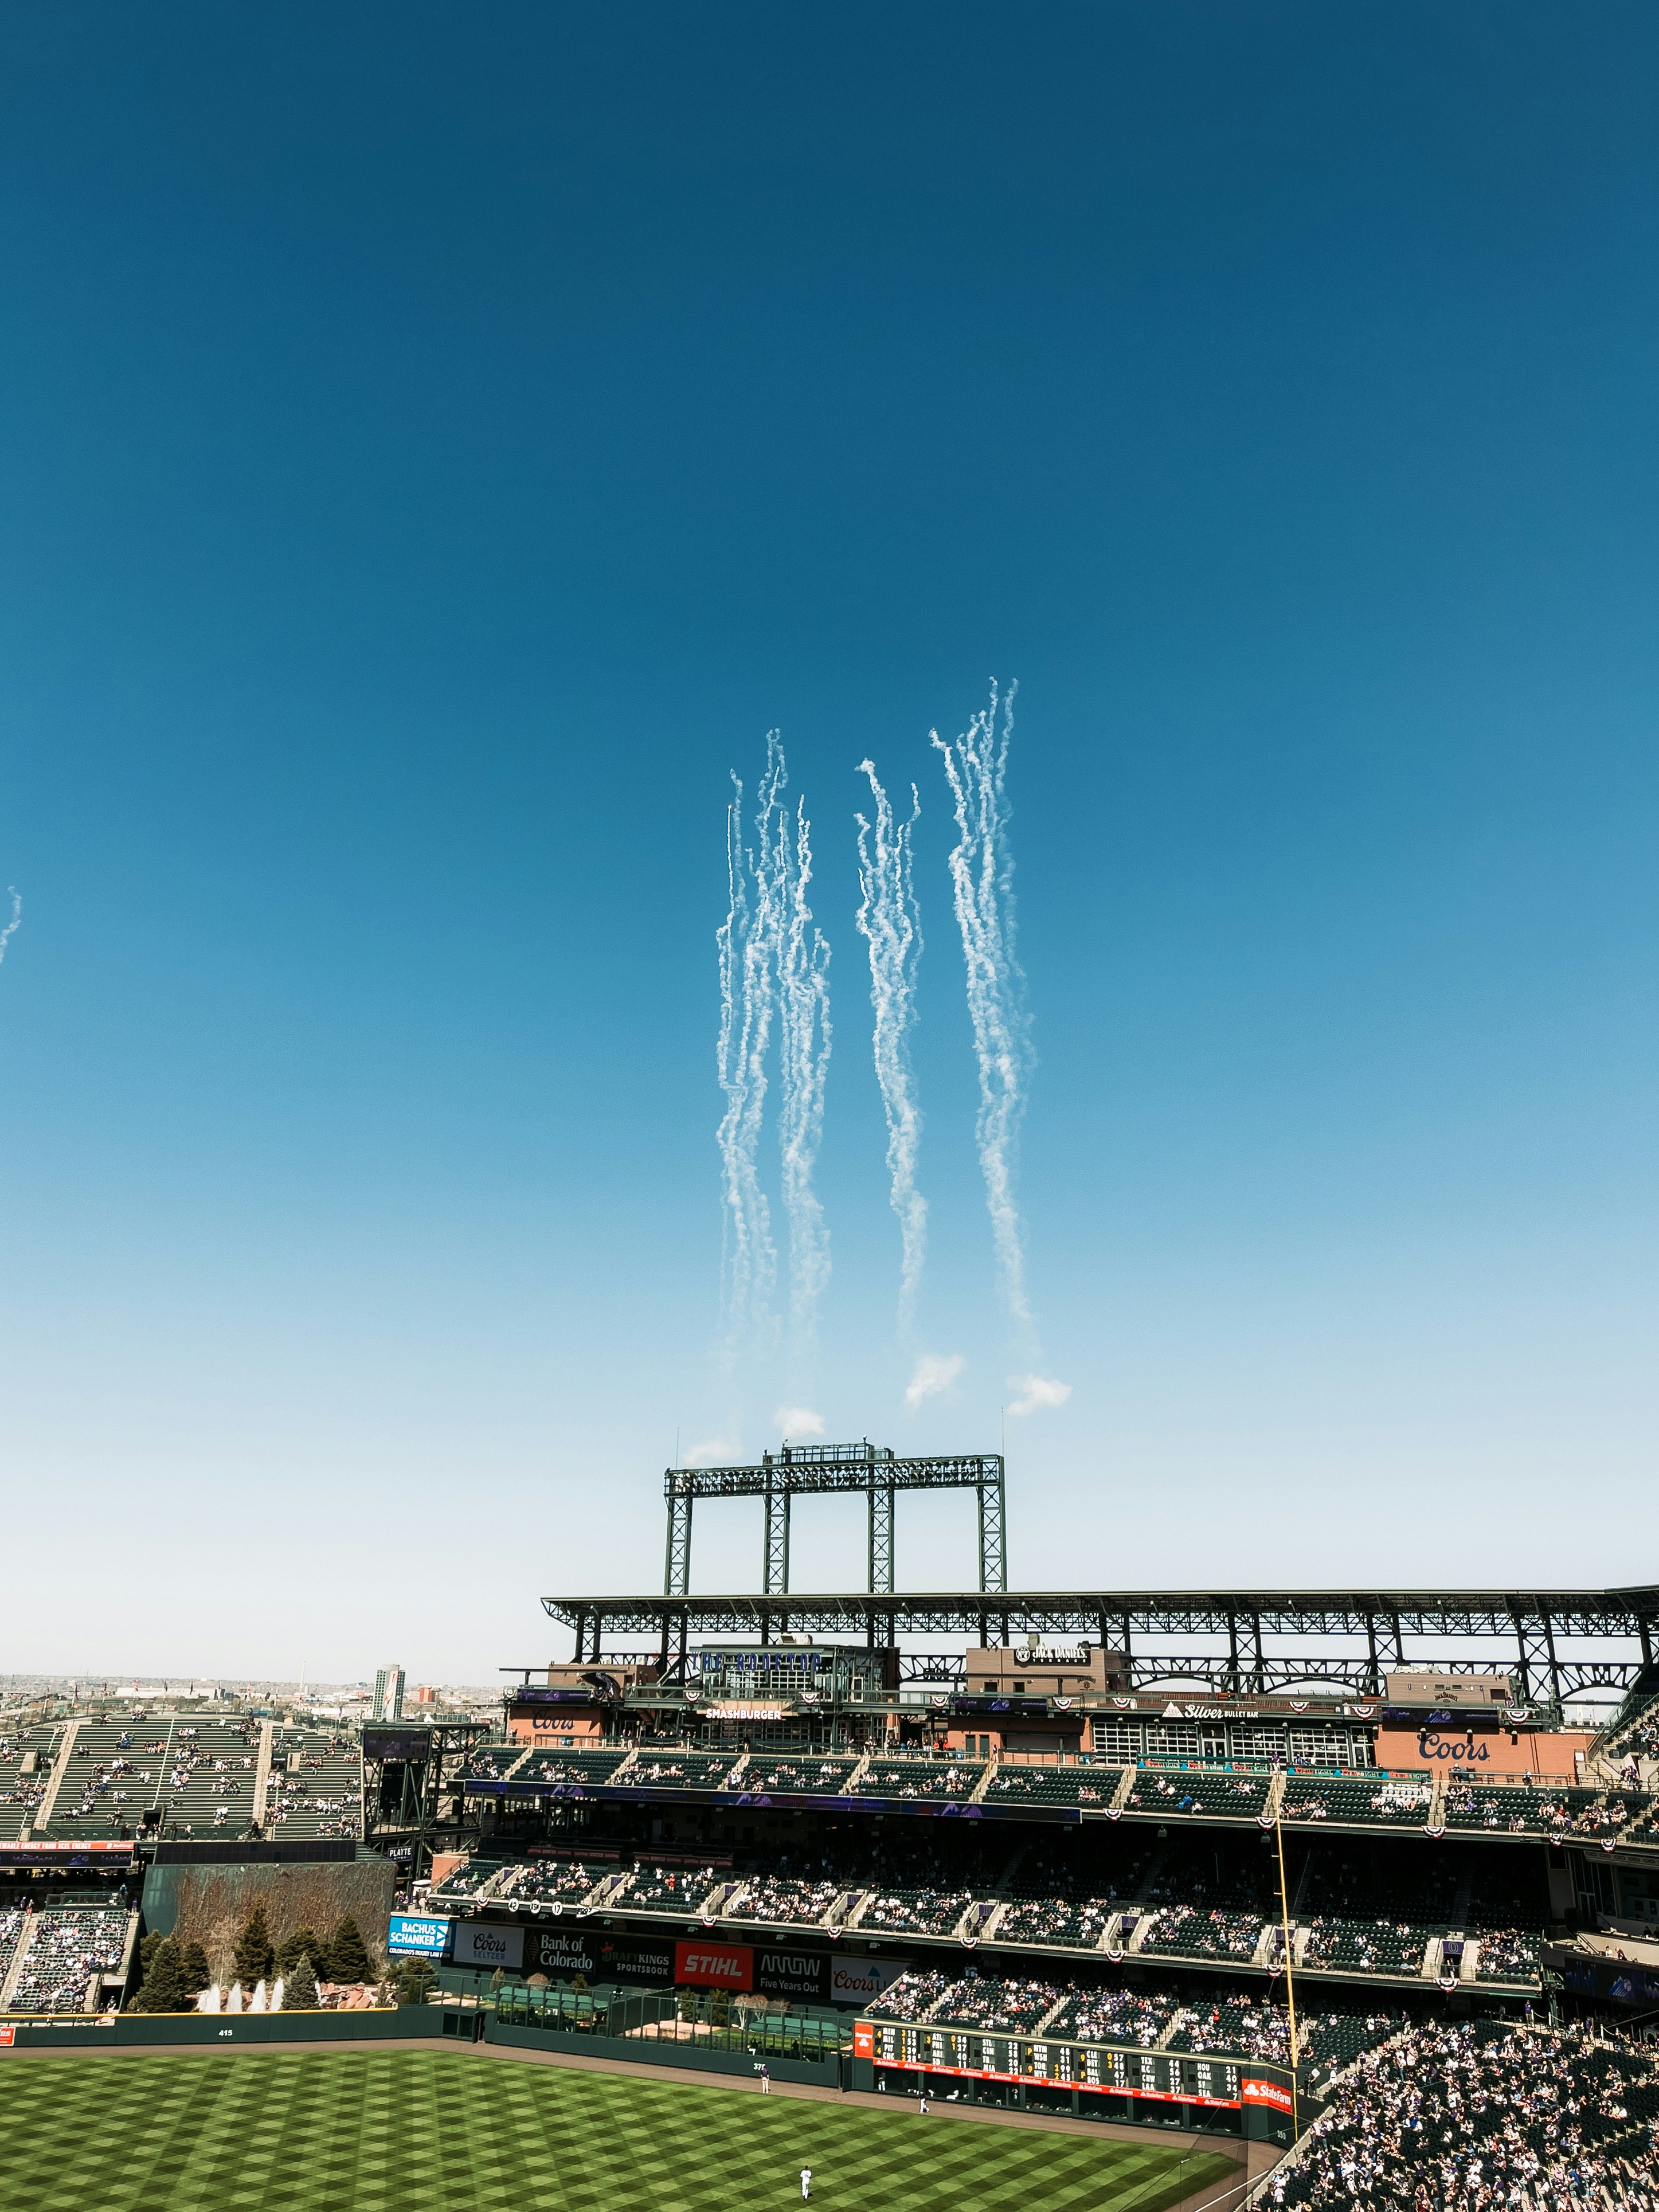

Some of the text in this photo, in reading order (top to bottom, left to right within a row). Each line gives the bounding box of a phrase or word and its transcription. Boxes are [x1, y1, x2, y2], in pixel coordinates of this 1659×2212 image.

[1032, 1646, 1054, 1658] JACK
[692, 1653, 821, 1672] THE ROOFTOP
[706, 1709, 782, 1720] SMASHBURGER
[1184, 1704, 1223, 1718] Silver
[533, 1709, 574, 1730] Coors
[1417, 1732, 1490, 1761] Coors
[390, 1848, 411, 1857] PLATTE
[509, 1901, 517, 1910] 42
[554, 1905, 561, 1913] 17
[1126, 1917, 1134, 1927] A
[402, 1922, 436, 1935] BACHUS
[390, 1932, 436, 1945] SCHANKER
[473, 1933, 507, 1952] Coors
[541, 1935, 584, 1952] Bank of
[1448, 1941, 1458, 1953] O
[473, 1951, 505, 1960] SELTZER
[540, 1951, 593, 1969] Colorado
[602, 1950, 670, 1966] DRAFTKINGS
[617, 1963, 668, 1975] SPORTSBOOK
[684, 1955, 742, 1976] STIHL
[761, 1955, 820, 1976] ARROW
[760, 1978, 819, 1992] Five Years Out
[834, 1970, 875, 1992] Coors
[883, 2027, 895, 2035] MIN
[883, 2035, 894, 2043] MIL
[907, 2038, 916, 2046] 53
[932, 2033, 942, 2041] ATL
[957, 2035, 967, 2043] 54
[884, 2043, 893, 2052] PIT
[932, 2041, 942, 2049] PHI
[983, 2038, 1018, 2050] STL 22
[932, 2050, 967, 2061] ARI 40
[983, 2047, 994, 2055] CIN
[1027, 2047, 1032, 2056] P
[1034, 2045, 1047, 2053] NYM
[1086, 2050, 1097, 2059] CLE
[1114, 2053, 1124, 2061] 57
[983, 2056, 1018, 2067] TB 20
[1034, 2053, 1070, 2064] WSH 31
[1086, 2059, 1098, 2067] DET
[1141, 2057, 1179, 2068] TEX 44
[983, 2064, 1018, 2075] MIA 22
[1034, 2061, 1046, 2070] TOR
[1061, 2065, 1070, 2073] 99
[1141, 2065, 1180, 2076] KC 56
[1197, 2063, 1235, 2074] HOU 21
[1034, 2070, 1047, 2078] NYY
[1087, 2068, 1098, 2076] BAL
[1114, 2071, 1125, 2079] 47
[1198, 2071, 1237, 2082] OAK 40
[1087, 2076, 1100, 2085] BOS
[1142, 2074, 1180, 2085] CHW 27
[1142, 2082, 1180, 2094] LAA 37
[1198, 2080, 1237, 2092] SF 34
[1198, 2089, 1211, 2097] SEA
